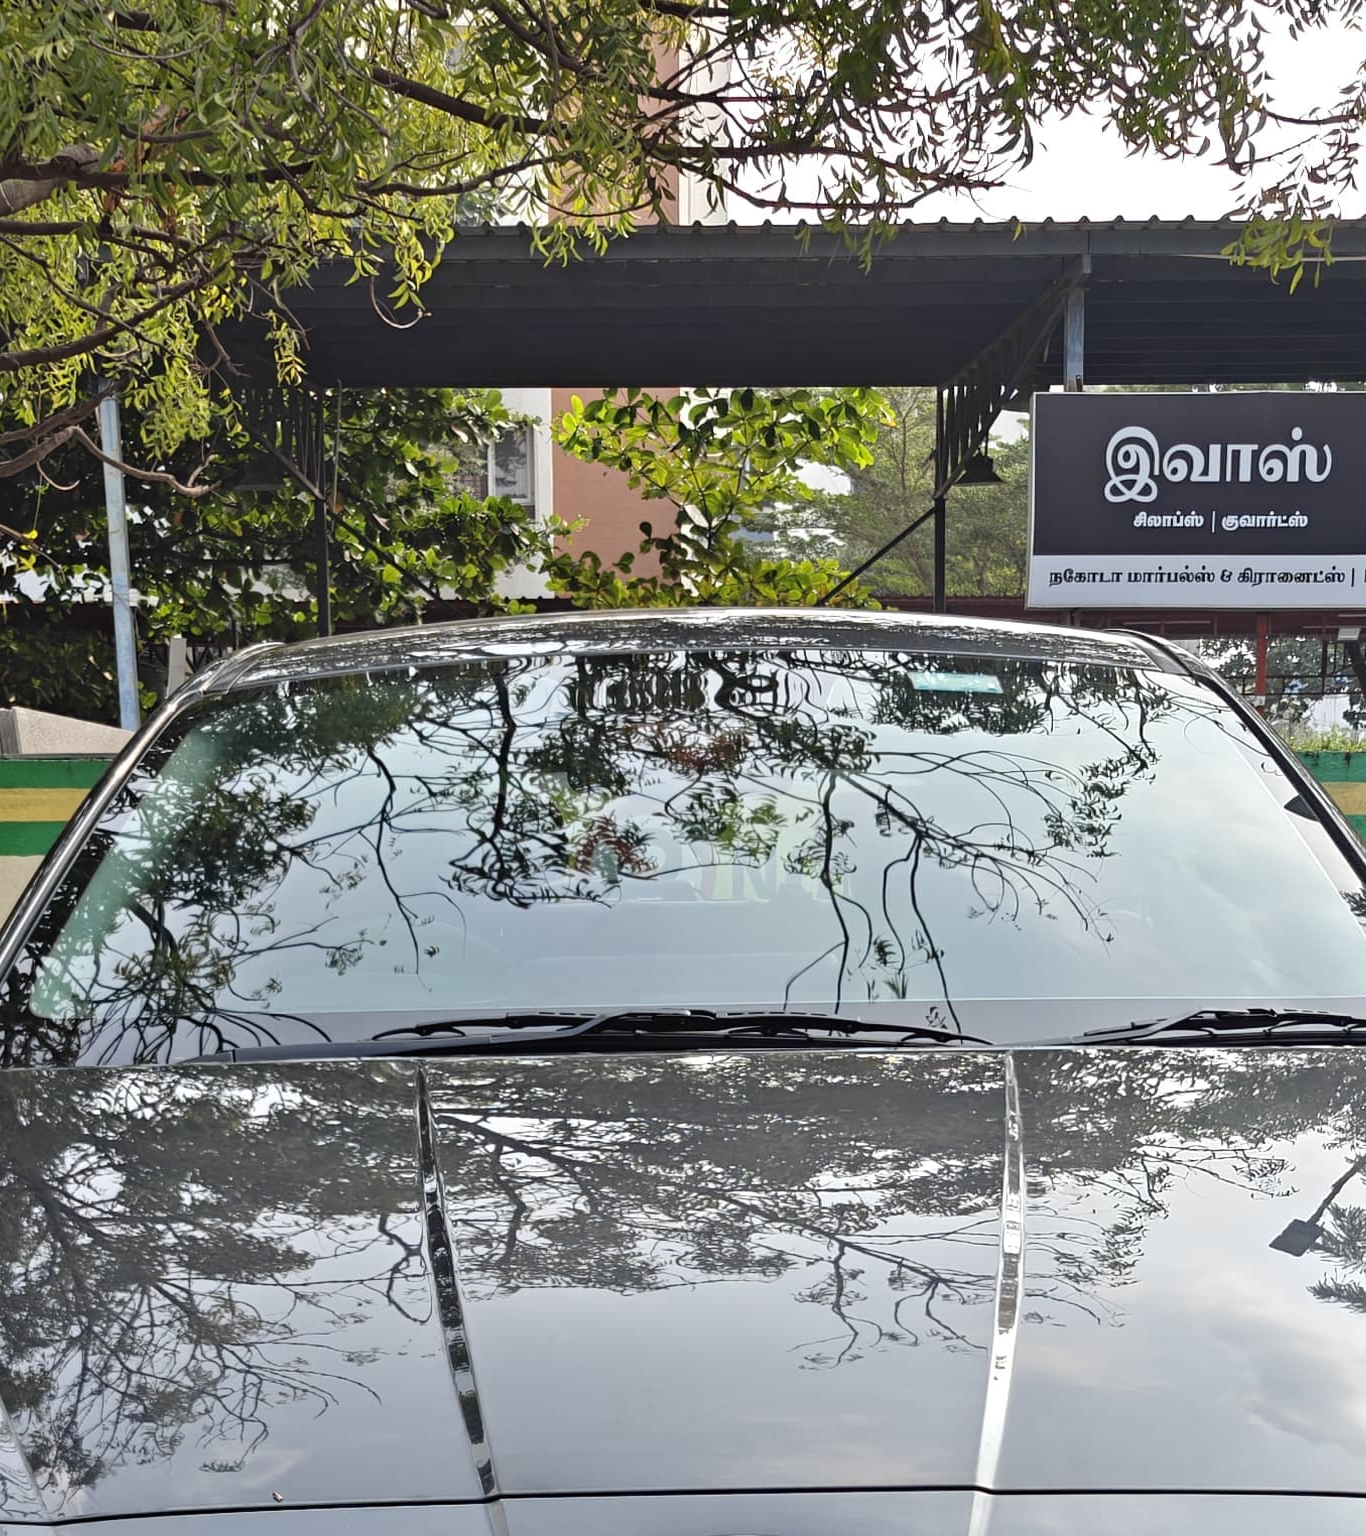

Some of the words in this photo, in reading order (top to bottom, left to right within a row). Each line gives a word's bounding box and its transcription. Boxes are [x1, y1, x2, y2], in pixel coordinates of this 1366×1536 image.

[1104, 426, 1332, 502] இவாஸ்
[1133, 511, 1204, 528] சிலாப்ஸ்
[1221, 511, 1308, 531] குவார்ட்ஸ்
[1127, 566, 1215, 584] மார்பல்ஸ்
[1220, 569, 1233, 583] &
